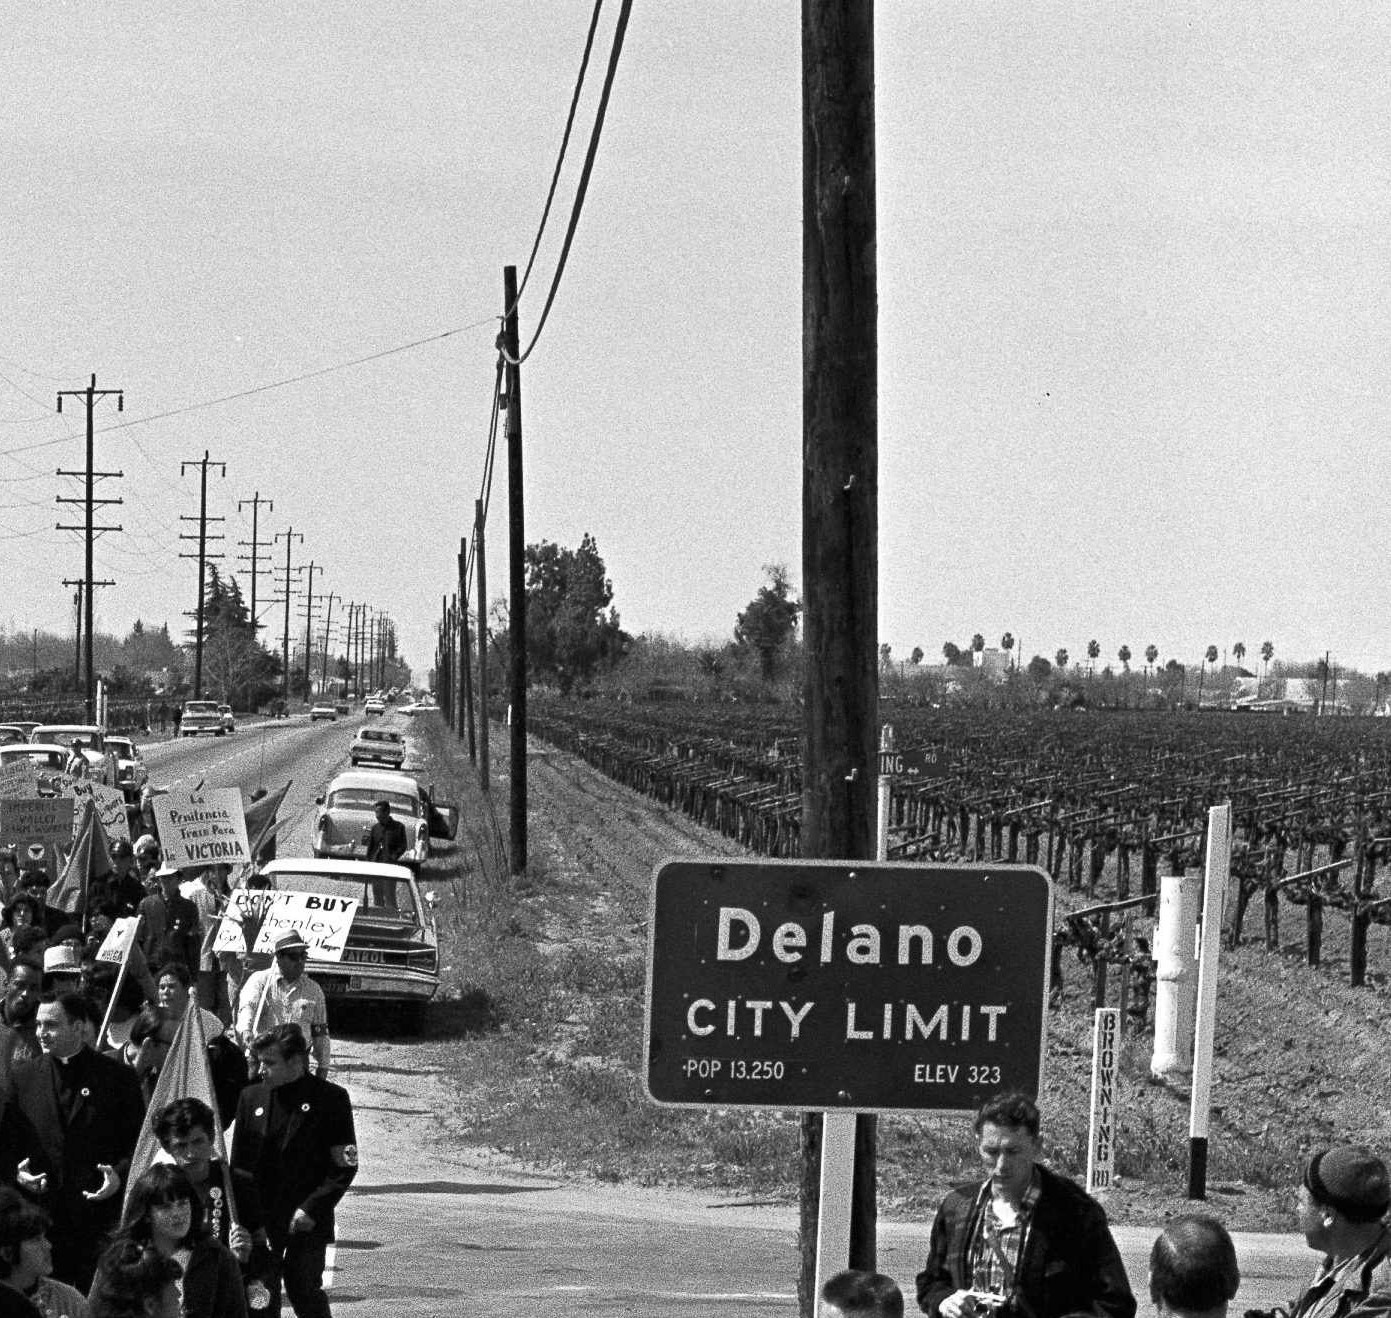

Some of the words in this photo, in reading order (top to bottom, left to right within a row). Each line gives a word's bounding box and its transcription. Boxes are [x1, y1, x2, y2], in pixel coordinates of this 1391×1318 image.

[881, 755, 903, 773] ING
[925, 753, 937, 763] RD
[73, 783, 94, 796] Buy
[191, 795, 205, 803] La
[170, 809, 230, 824] Penitencia
[212, 824, 236, 835] Para
[185, 841, 244, 860] VICTORIA
[306, 896, 352, 913] BUY
[263, 912, 342, 940] henley
[717, 907, 983, 967] Delano
[687, 999, 815, 1037] CITY
[846, 1002, 1007, 1041] LIMIT
[687, 1059, 722, 1078] POP
[914, 1064, 959, 1083] ELEV
[967, 1066, 1001, 1084] 323
[1097, 1013, 1116, 1161] BROWNING
[1092, 1170, 1109, 1187] RD
